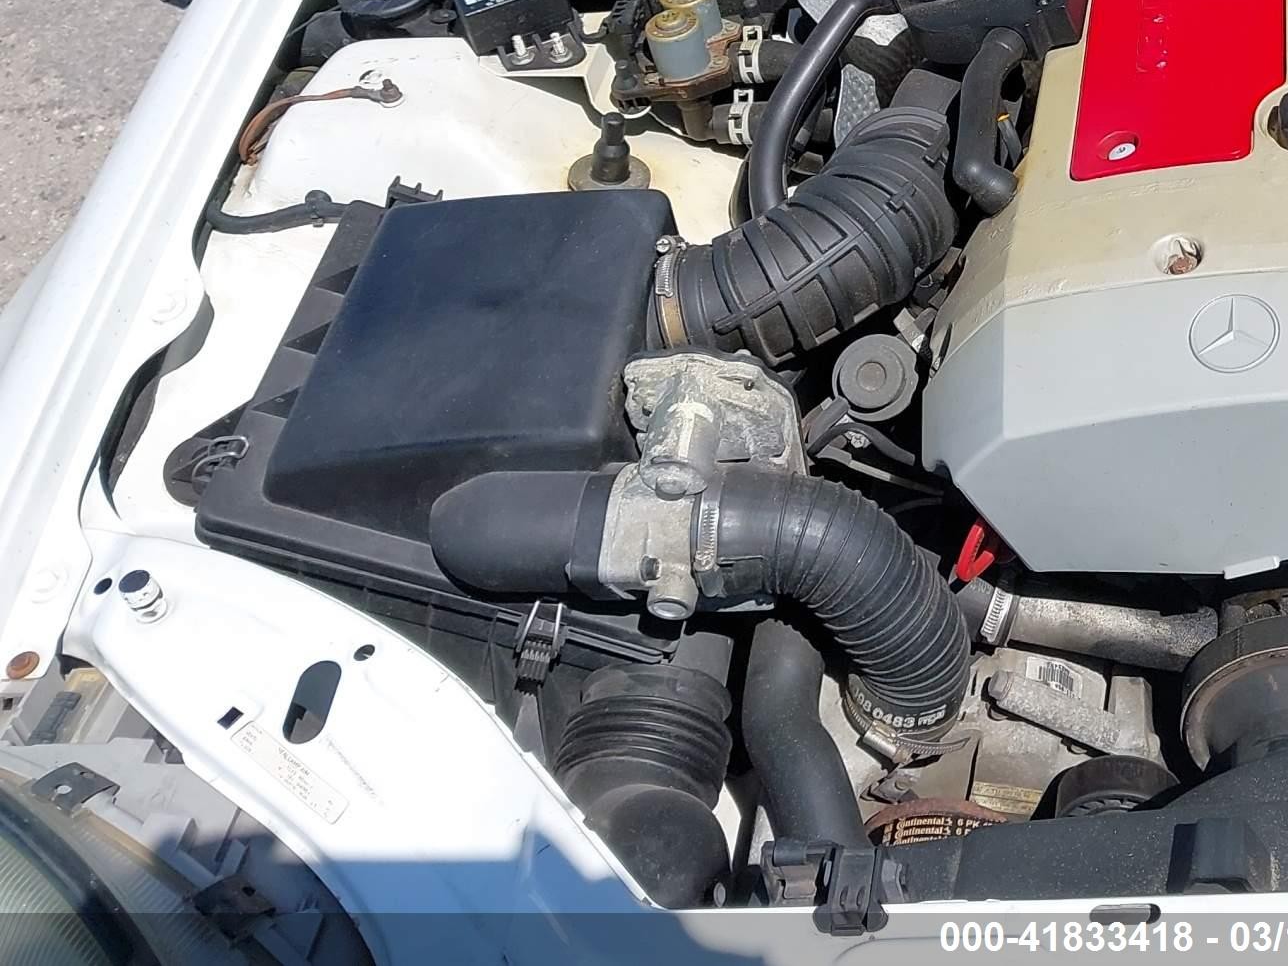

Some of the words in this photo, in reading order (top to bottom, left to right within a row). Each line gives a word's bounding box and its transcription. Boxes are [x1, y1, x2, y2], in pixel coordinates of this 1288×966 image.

[872, 707, 916, 728] 0483
[896, 817, 944, 831] Continental
[957, 818, 964, 826] 6
[965, 819, 980, 828] PK
[895, 826, 943, 839] Continental
[955, 827, 962, 836] 6
